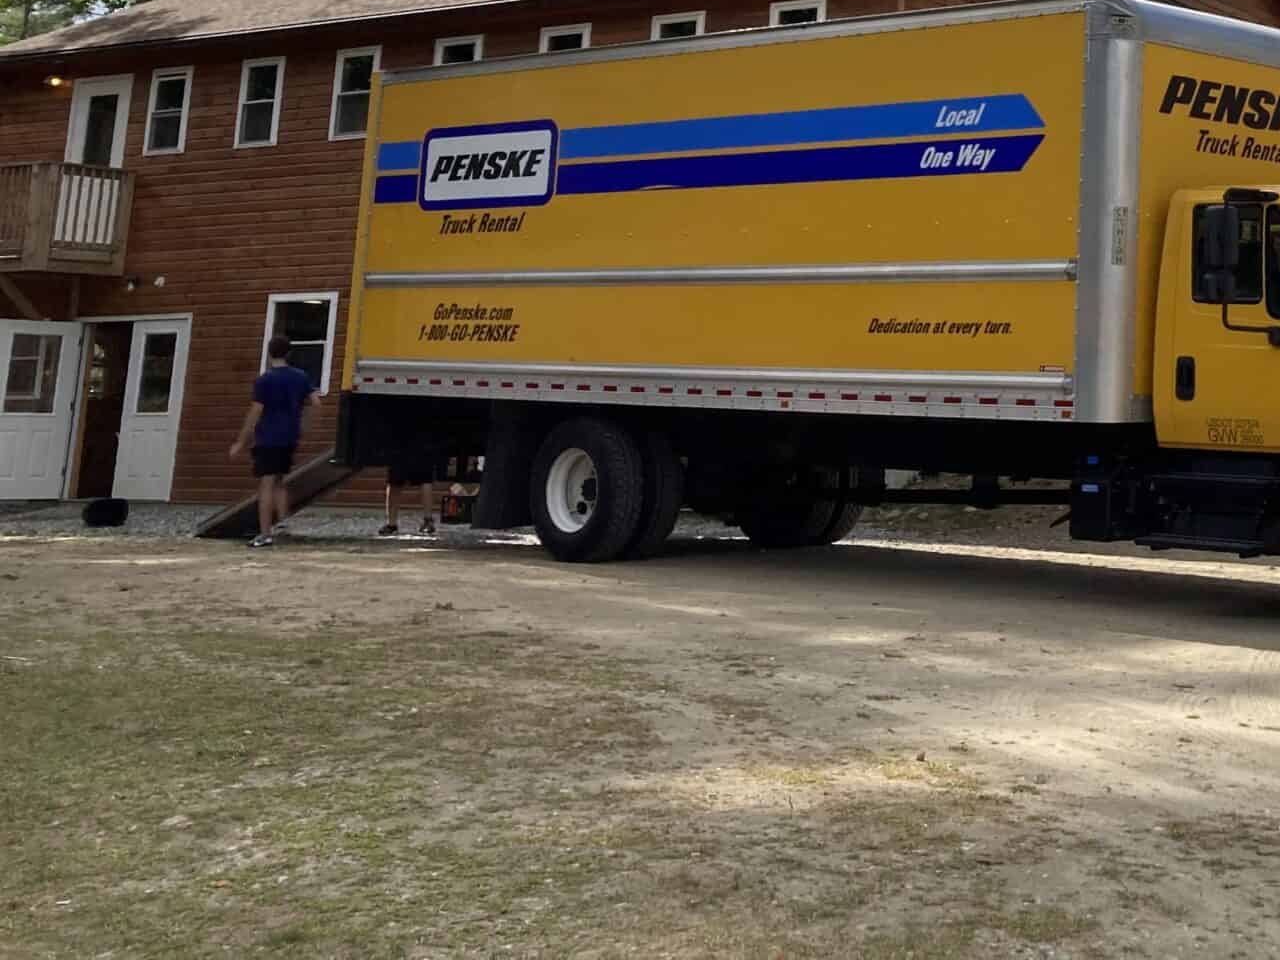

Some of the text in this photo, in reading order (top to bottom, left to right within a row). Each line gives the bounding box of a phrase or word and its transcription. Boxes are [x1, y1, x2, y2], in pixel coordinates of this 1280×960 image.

[936, 103, 986, 127] Local
[1196, 129, 1238, 157] Truck
[430, 149, 545, 183] PENSKE
[919, 144, 996, 170] One Way
[439, 212, 526, 235] Truck Rental
[433, 303, 514, 321] GoPenske.com
[418, 324, 520, 342] 1-800-GO-PENSKE
[868, 318, 1013, 338] Dedication at every turn.
